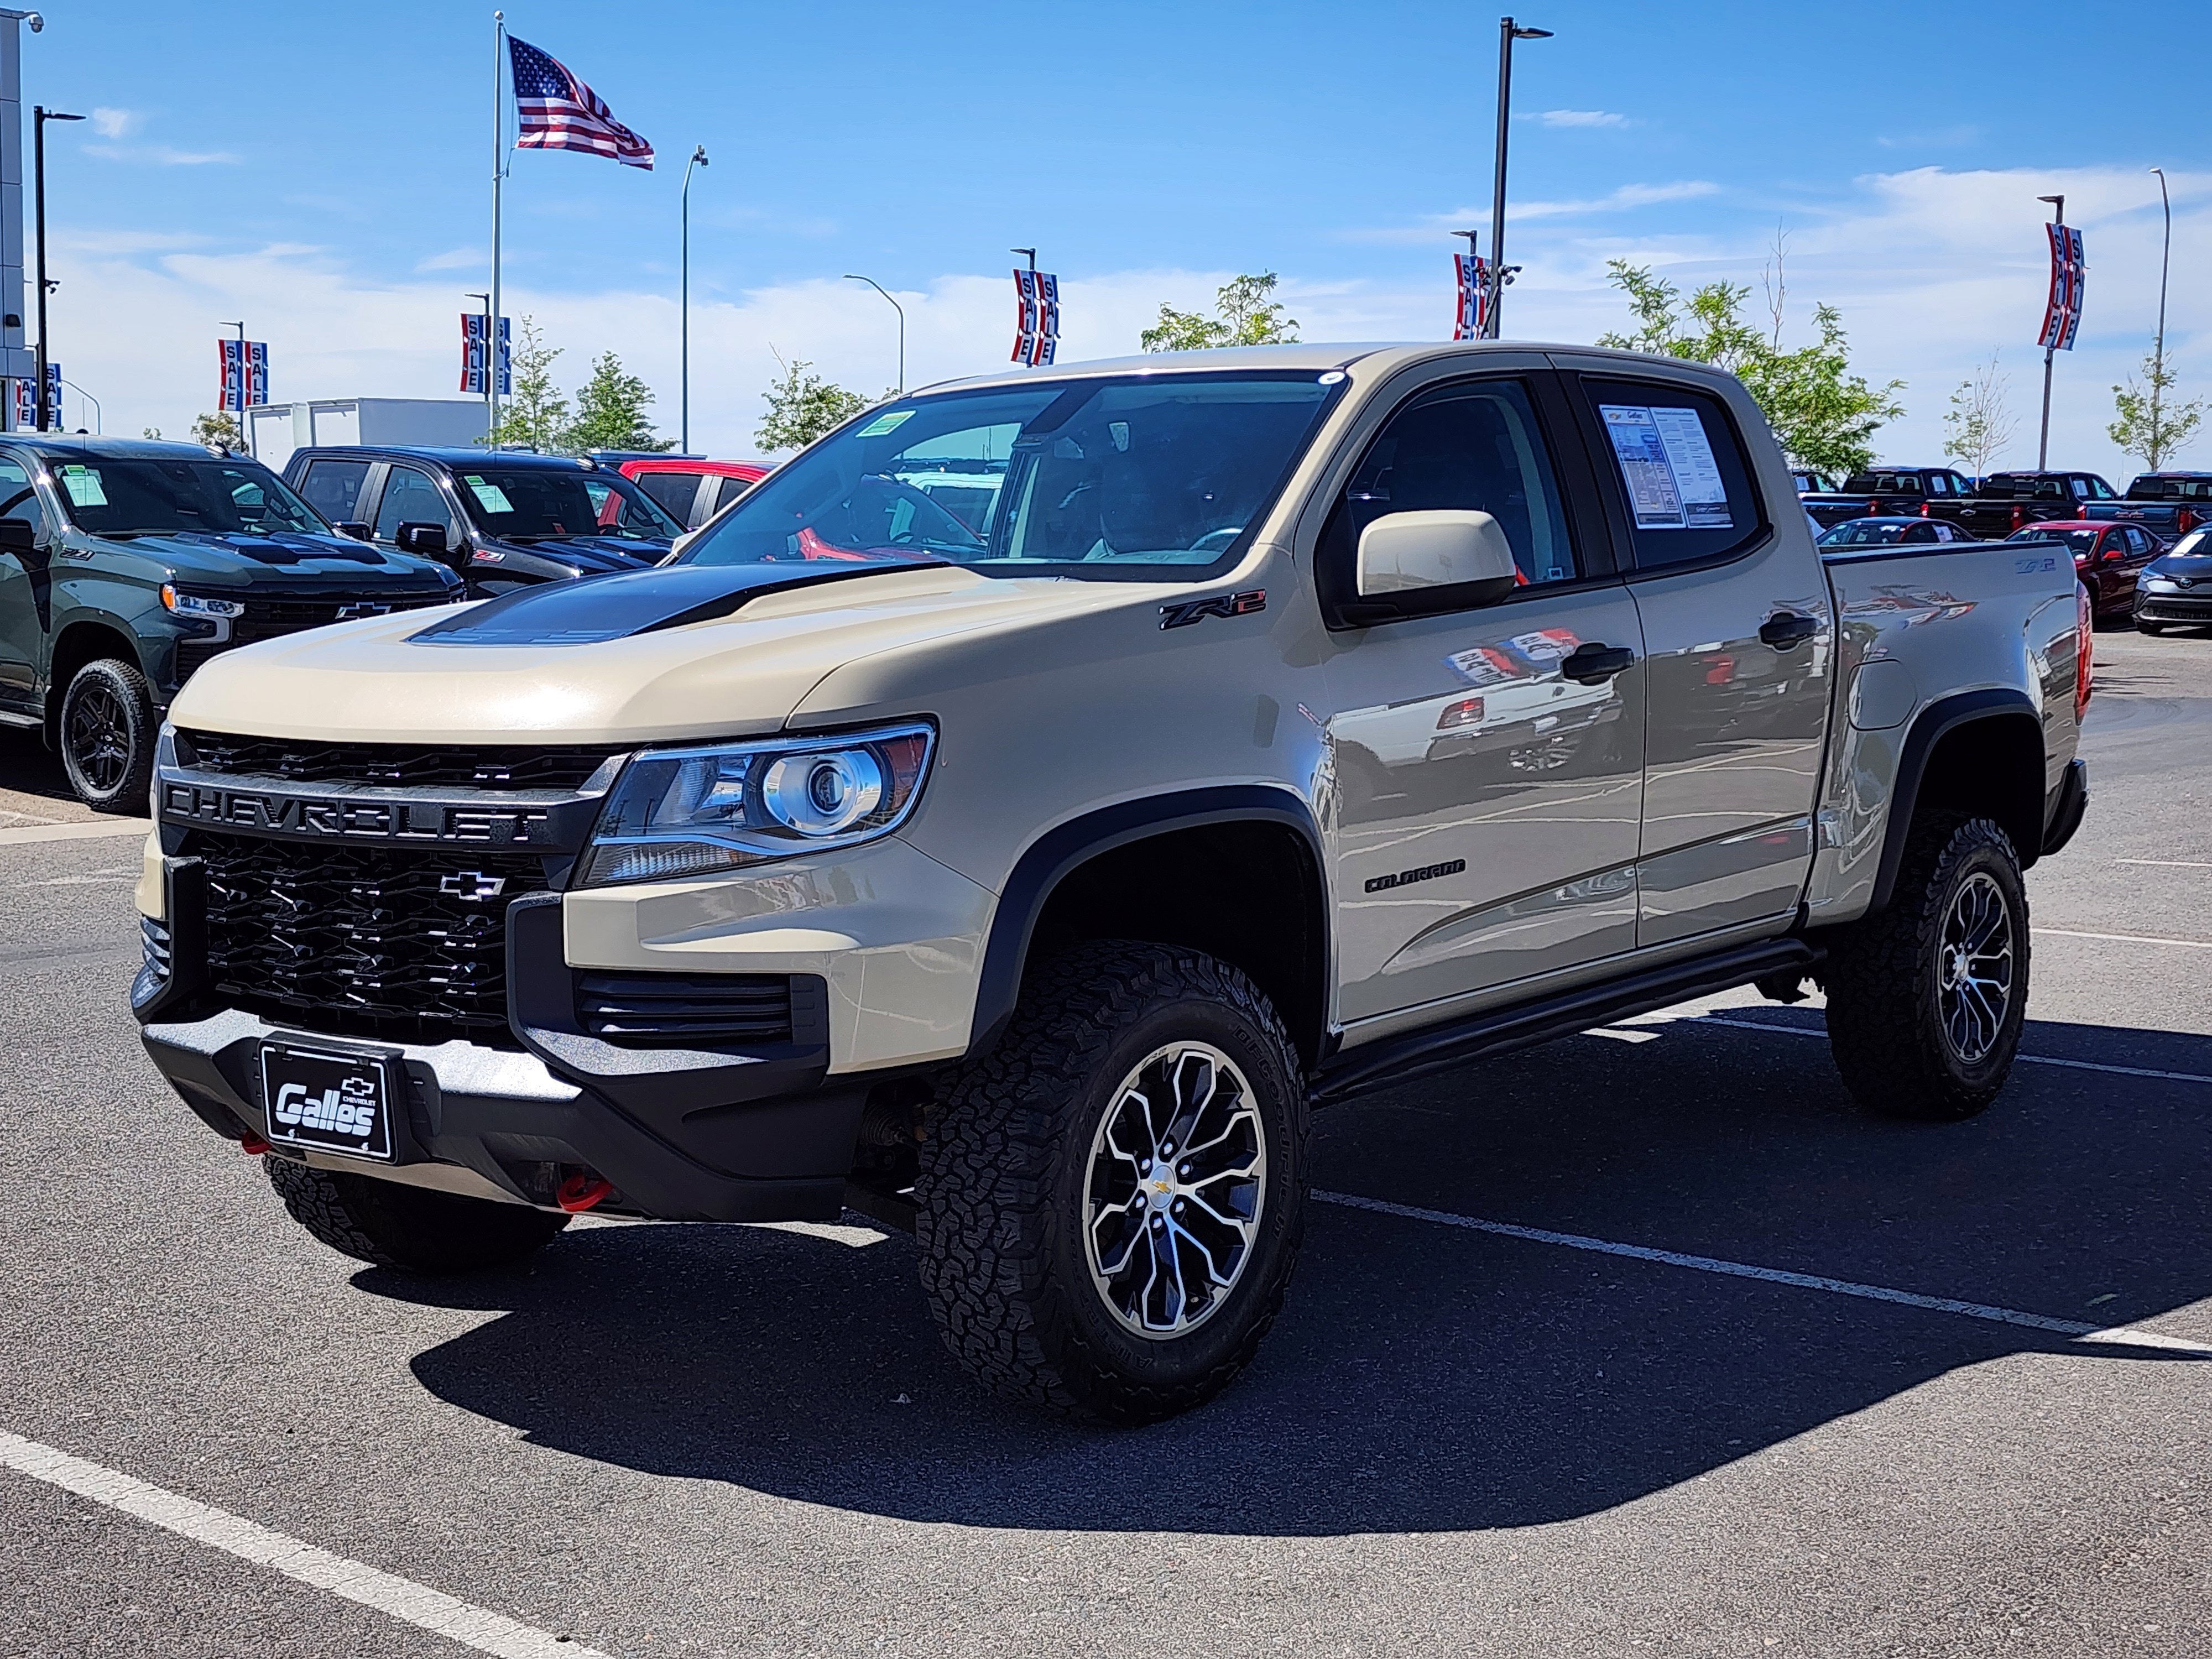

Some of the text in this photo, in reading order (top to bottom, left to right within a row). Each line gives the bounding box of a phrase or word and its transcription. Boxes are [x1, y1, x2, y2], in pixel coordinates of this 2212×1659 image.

[1462, 264, 1472, 340] SAL
[2047, 233, 2063, 337] SALE
[2065, 238, 2081, 340] SALE
[1020, 278, 1034, 356] SALE
[1042, 281, 1055, 358] SALE
[226, 346, 237, 405] SALE
[252, 347, 262, 405] SALE
[468, 321, 478, 386] SALE
[22, 381, 30, 421] ALE
[46, 368, 56, 422] SALE
[2016, 558, 2056, 574] ZR2
[1159, 588, 1266, 630] ZR2
[166, 783, 549, 841] CHEVROLET
[1365, 859, 1466, 893] COLORADO
[342, 1096, 376, 1107] CHEVROLET
